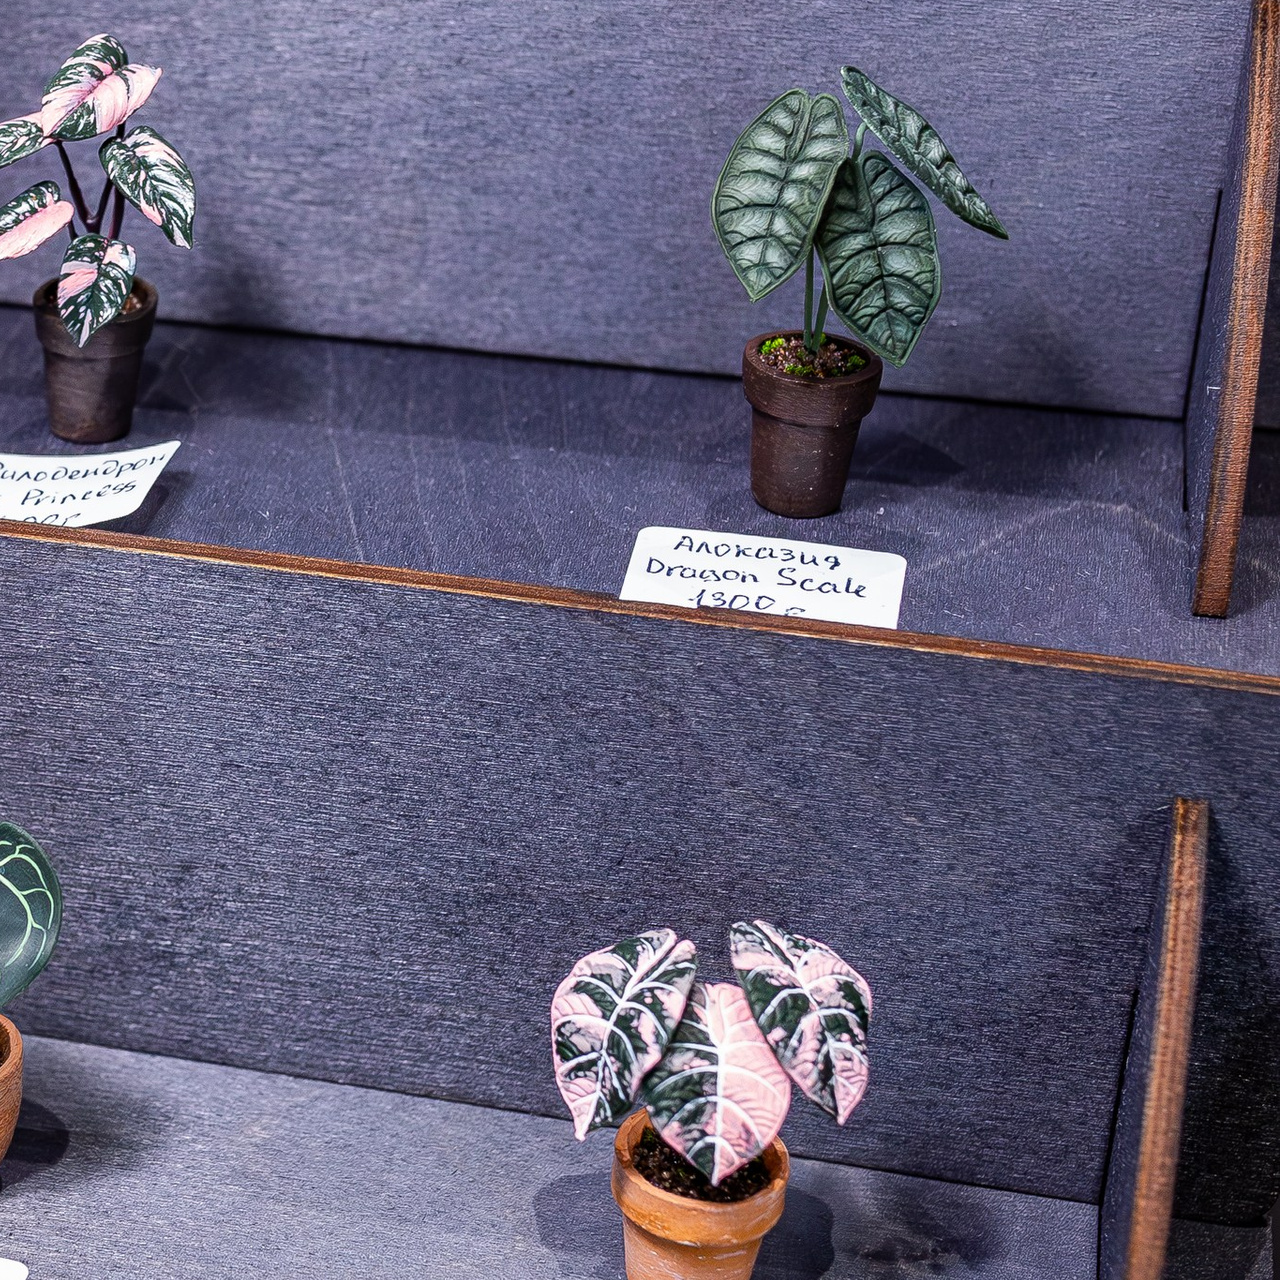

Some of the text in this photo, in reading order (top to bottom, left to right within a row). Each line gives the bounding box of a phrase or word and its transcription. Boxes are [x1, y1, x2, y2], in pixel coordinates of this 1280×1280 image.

[21, 480, 137, 506] Princess
[673, 535, 841, 568] Алоказия
[645, 556, 867, 598] Dragon Scale
